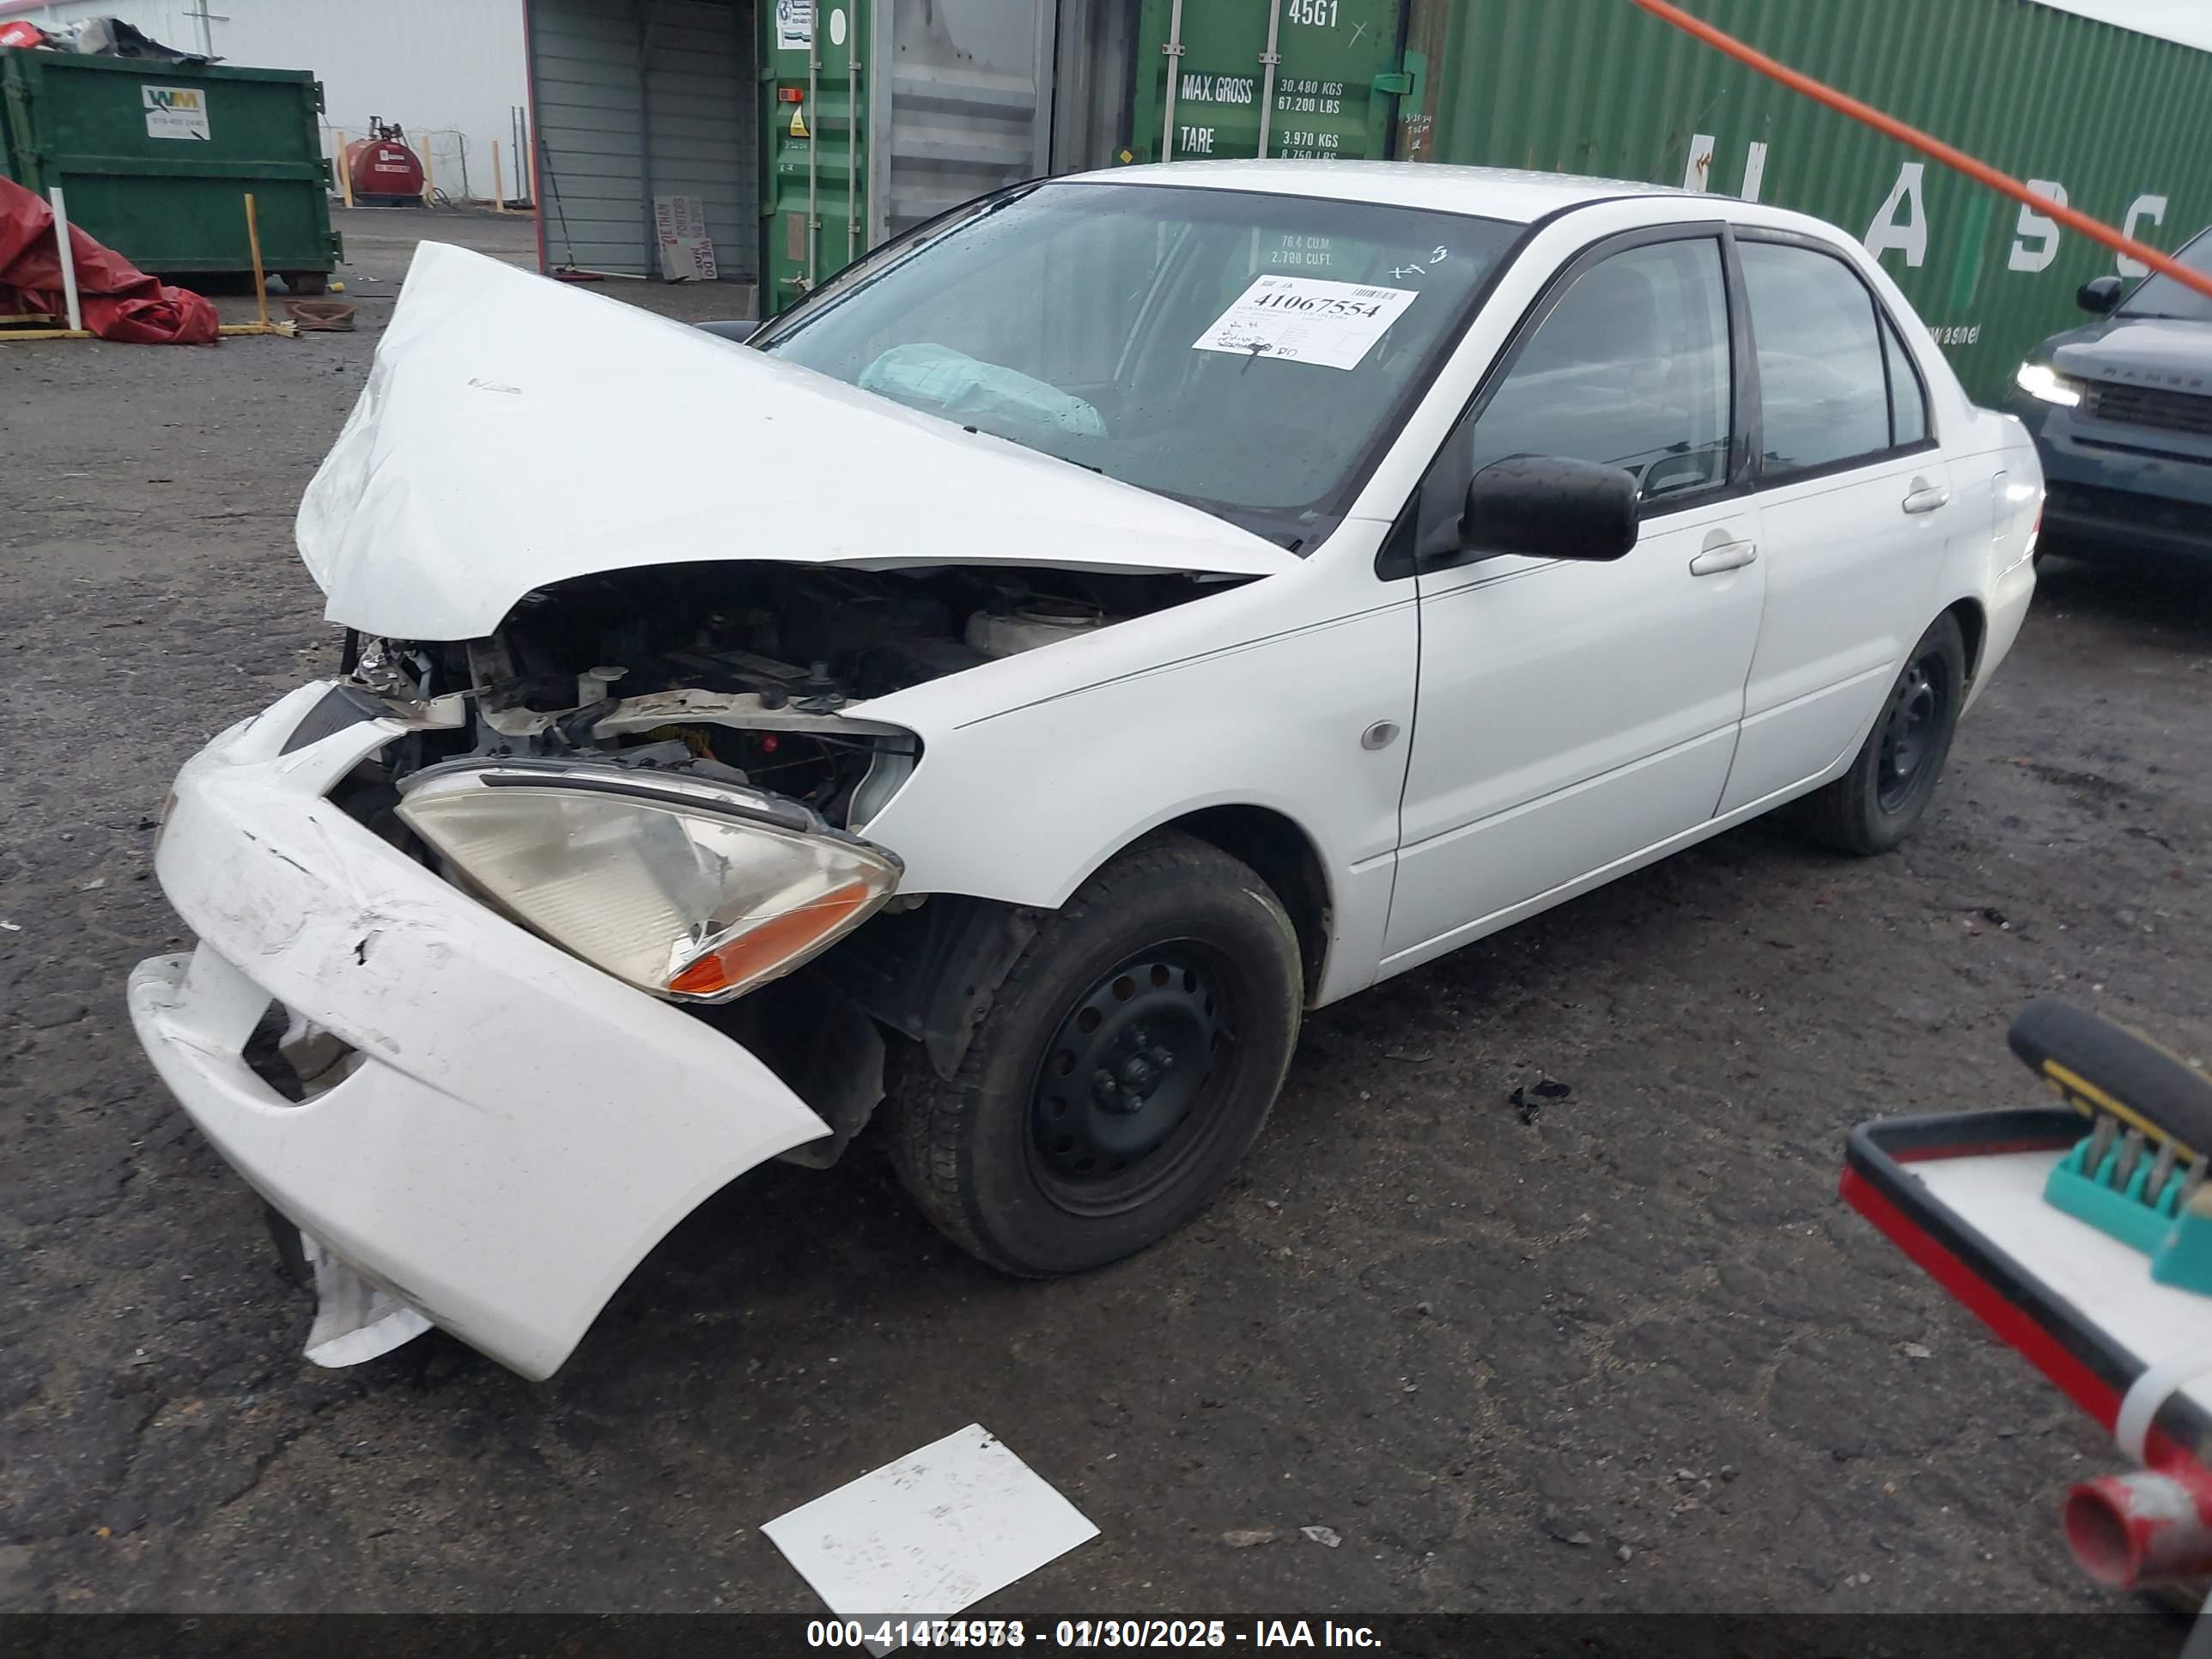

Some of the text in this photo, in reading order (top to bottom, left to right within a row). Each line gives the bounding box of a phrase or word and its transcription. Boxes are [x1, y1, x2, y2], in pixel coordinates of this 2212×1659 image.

[1289, 0, 1339, 27] 45G1
[148, 89, 199, 108] WM
[1215, 77, 1253, 104] GROSS
[1279, 79, 1343, 96] 30.480 KGS
[1278, 96, 1340, 113] 67.200 LBS
[1181, 126, 1214, 153] TARE
[1283, 131, 1339, 148] 3.970 KGS
[701, 240, 714, 276] WE DO
[1272, 251, 1302, 264] 2.700
[1254, 292, 1382, 319] 41067554
